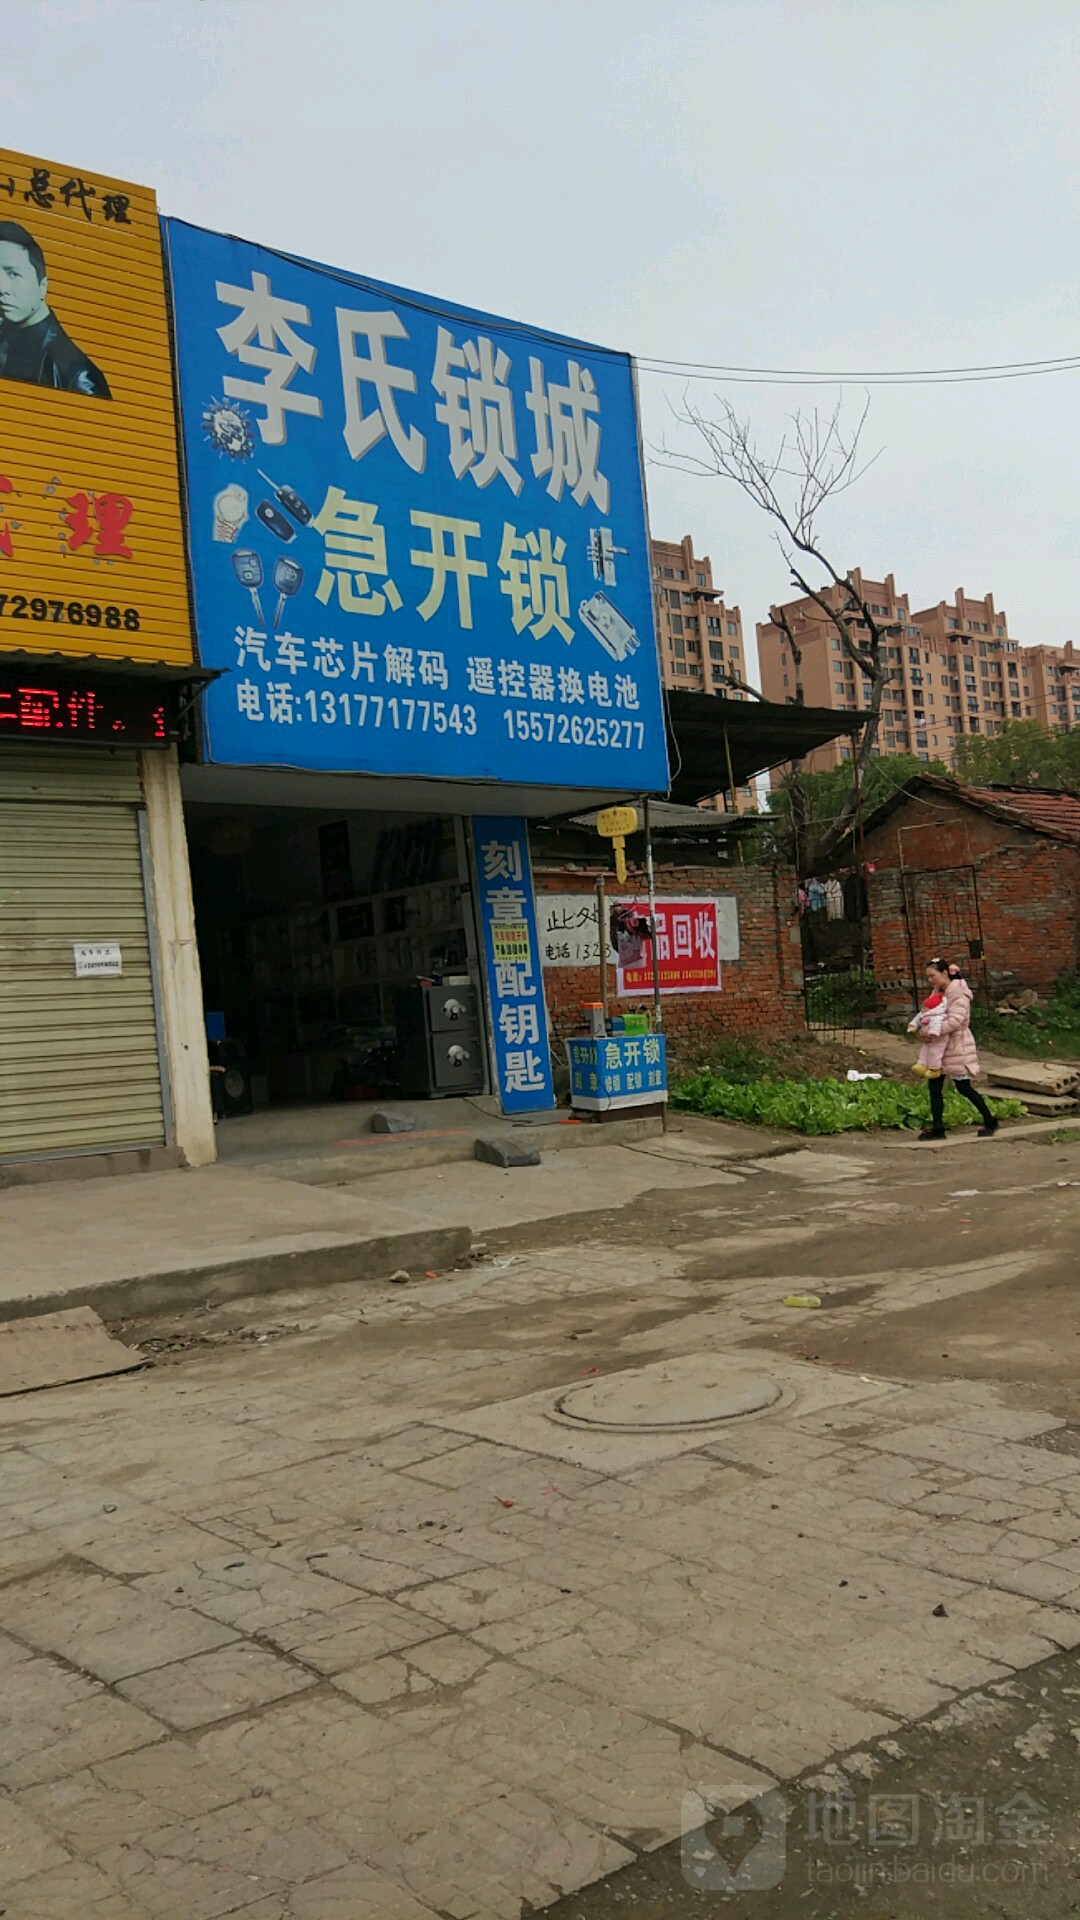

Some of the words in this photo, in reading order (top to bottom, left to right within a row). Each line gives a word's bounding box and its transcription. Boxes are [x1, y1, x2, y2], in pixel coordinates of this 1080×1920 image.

[215, 270, 610, 515] 李氏锁城
[0, 474, 134, 559] 理
[311, 485, 577, 646] 急开锁
[233, 625, 449, 691] 汽车芯片解码
[466, 656, 640, 711] 遥控器换电池
[503, 708, 645, 750] 15572625277
[634, 909, 716, 961] 品回收
[604, 1037, 661, 1070] 急开锁
